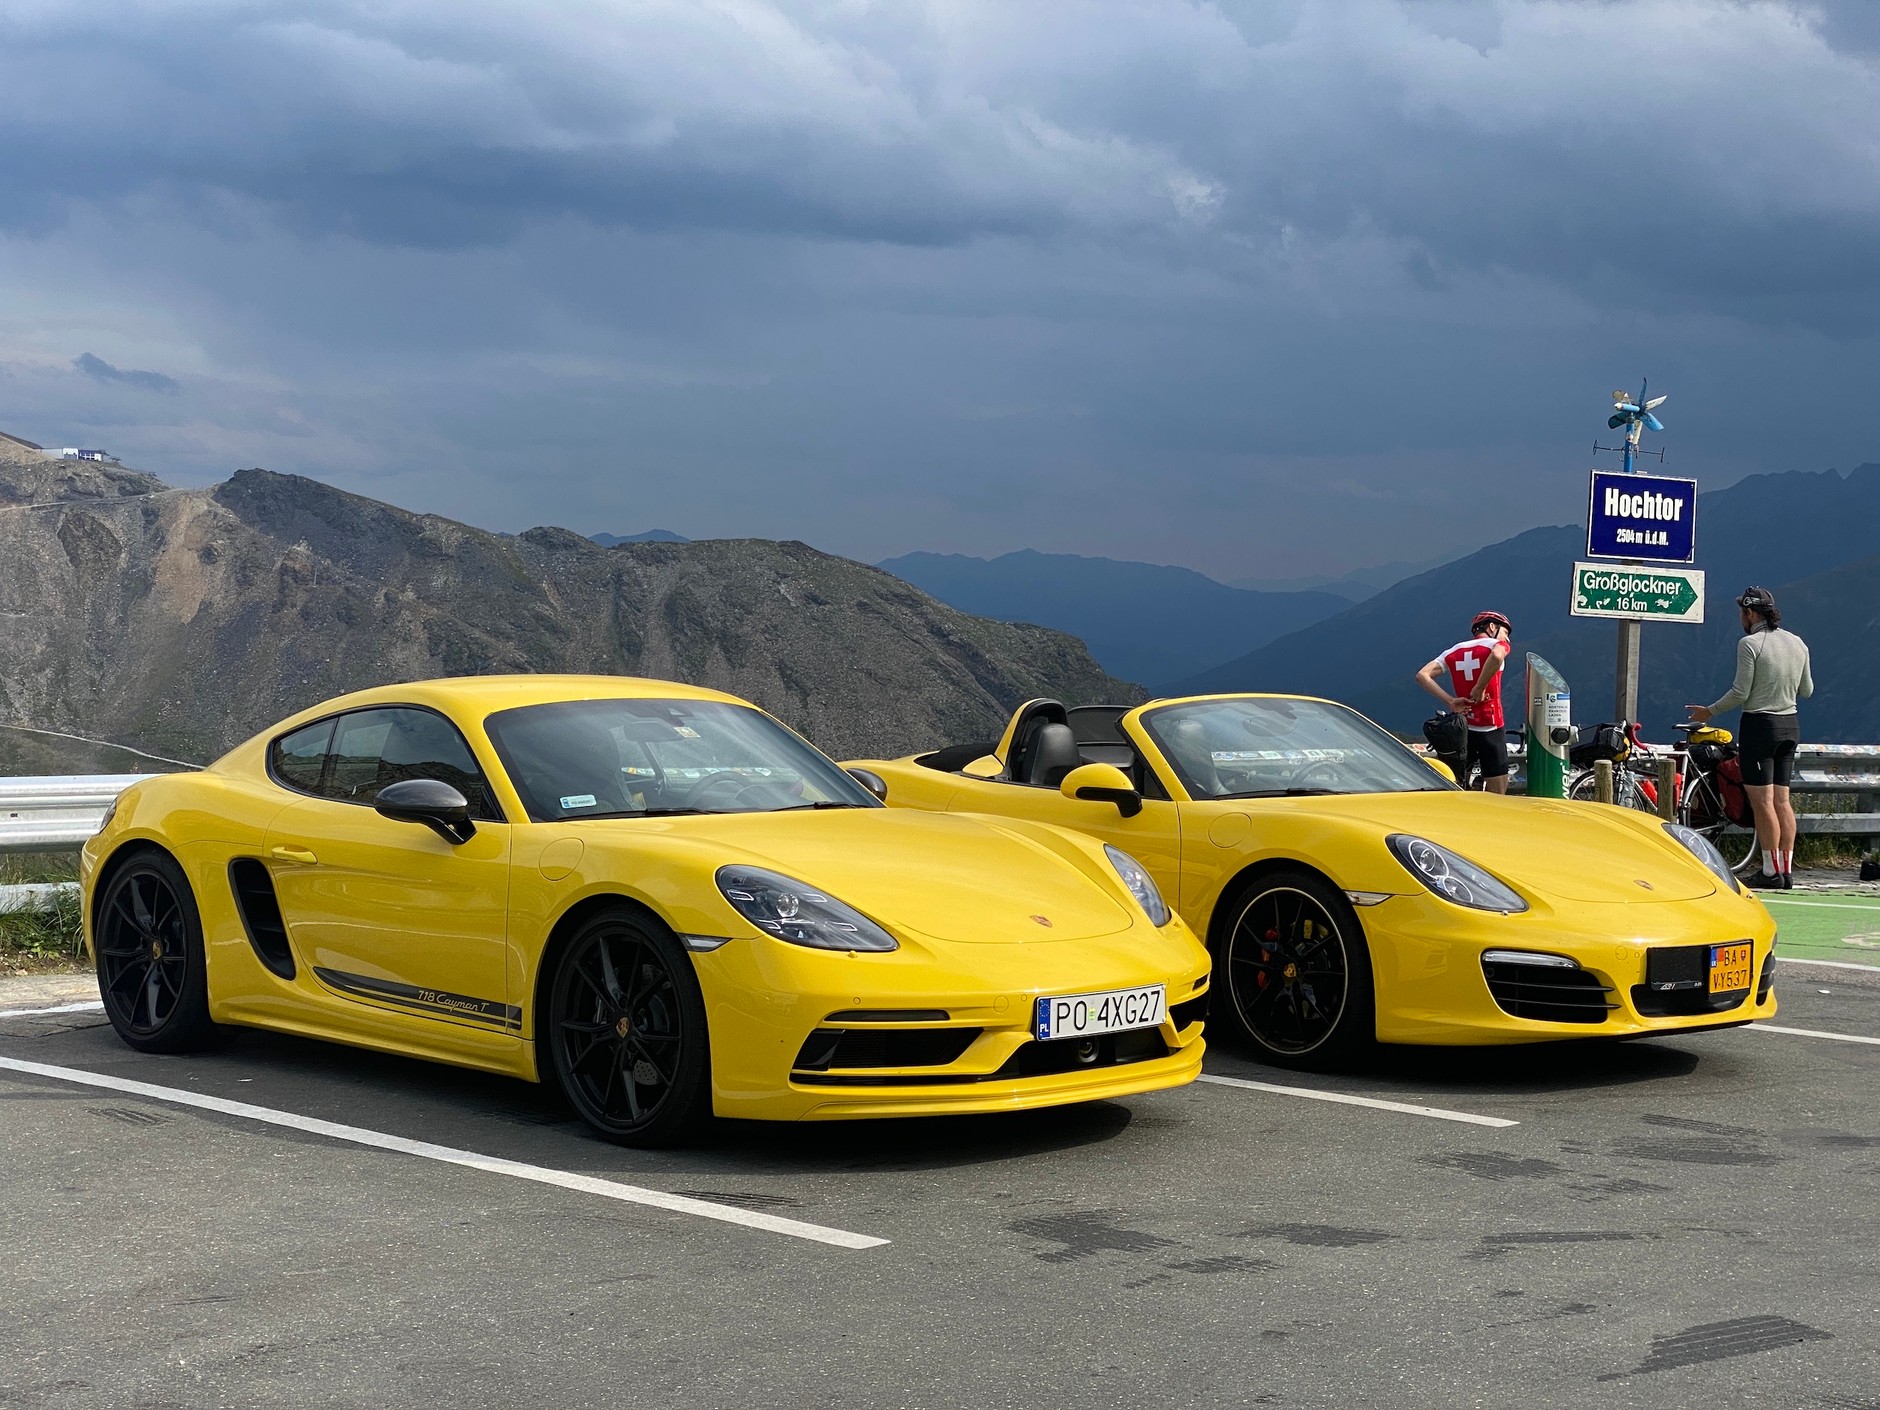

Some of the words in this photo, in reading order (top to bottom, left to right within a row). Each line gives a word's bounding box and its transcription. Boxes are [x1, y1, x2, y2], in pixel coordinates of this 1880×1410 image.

[1604, 487, 1684, 521] Hochtor
[1583, 571, 1681, 595] Großglockner
[1617, 597, 1629, 610] 16
[1631, 599, 1648, 612] km
[1724, 949, 1737, 966] BA
[418, 990, 435, 1002] 718
[436, 993, 478, 1012] Cayman
[480, 1002, 490, 1012] T
[1056, 1000, 1088, 1033] PO
[1097, 989, 1161, 1028] 4XG27
[1039, 1023, 1049, 1032] PL
